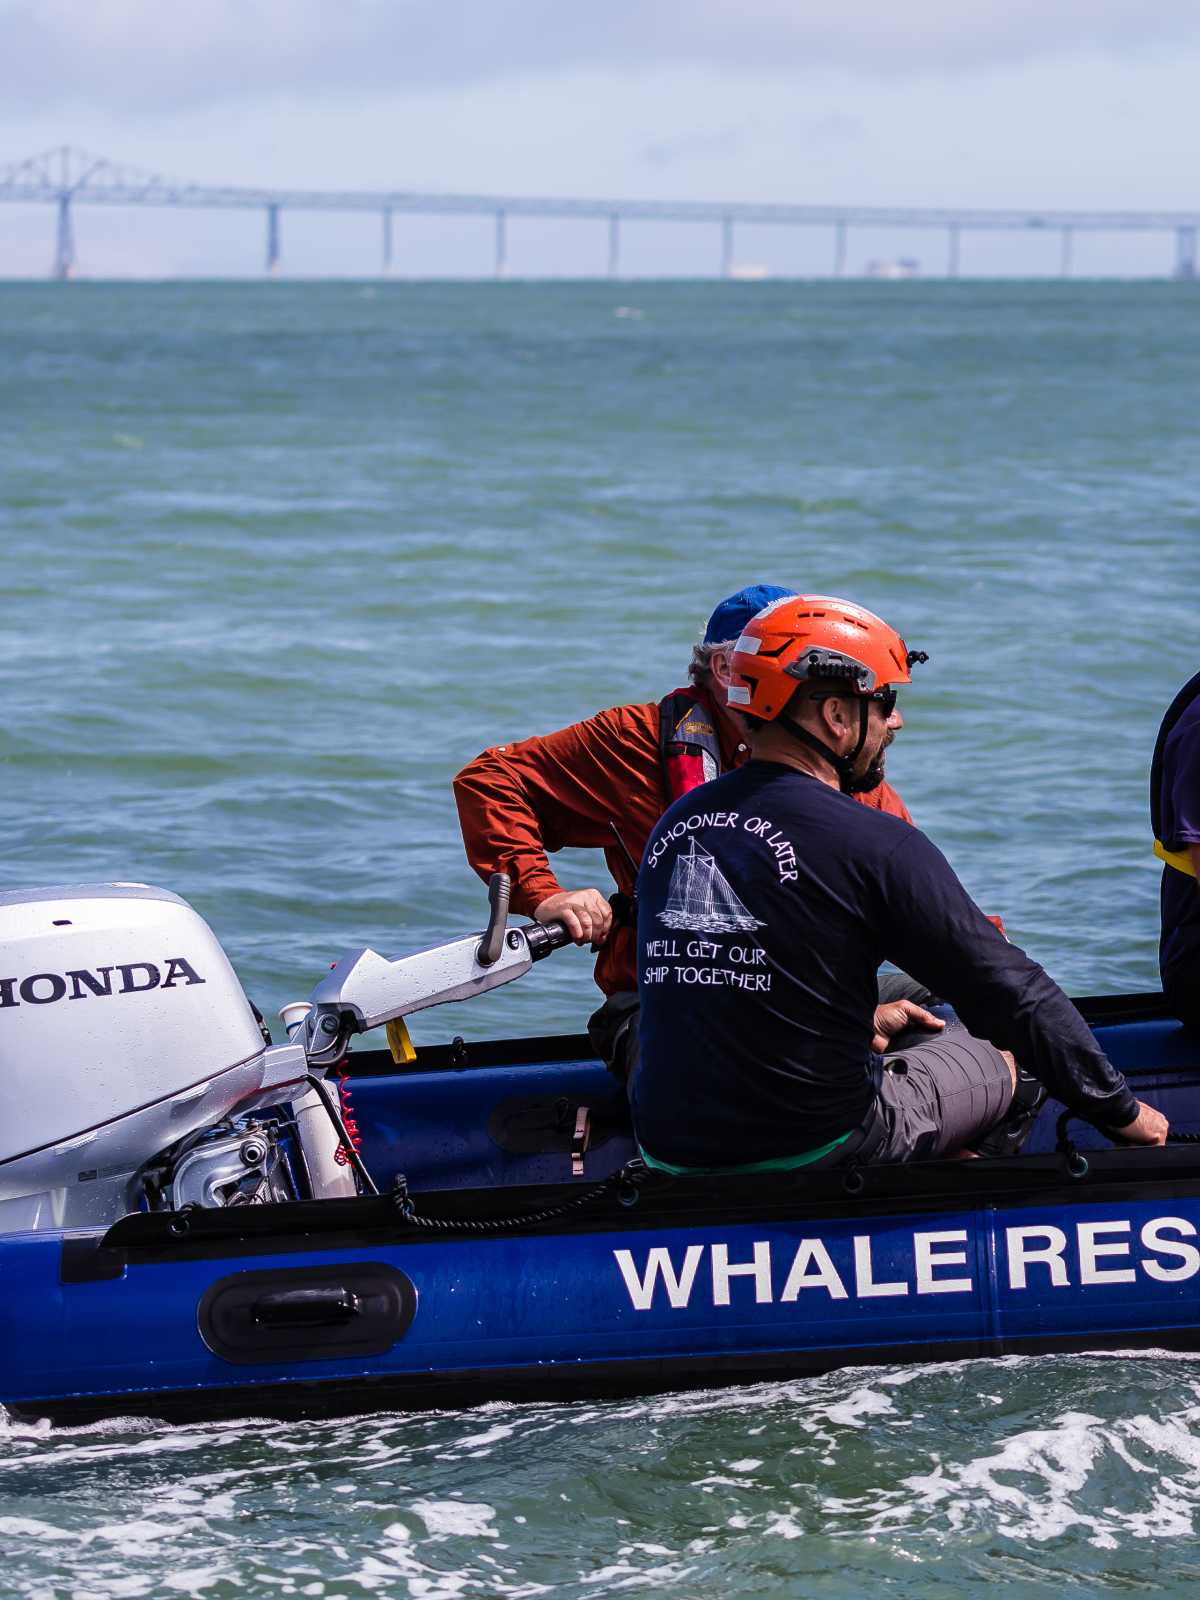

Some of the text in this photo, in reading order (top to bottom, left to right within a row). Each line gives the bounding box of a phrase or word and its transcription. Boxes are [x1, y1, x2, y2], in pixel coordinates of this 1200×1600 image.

[648, 812, 798, 883] SCHOONER OR LATER
[687, 941, 723, 959] GET
[729, 946, 766, 966] OUR
[644, 966, 771, 992] SHIP TOGETHER!
[613, 1230, 972, 1310] WHALE
